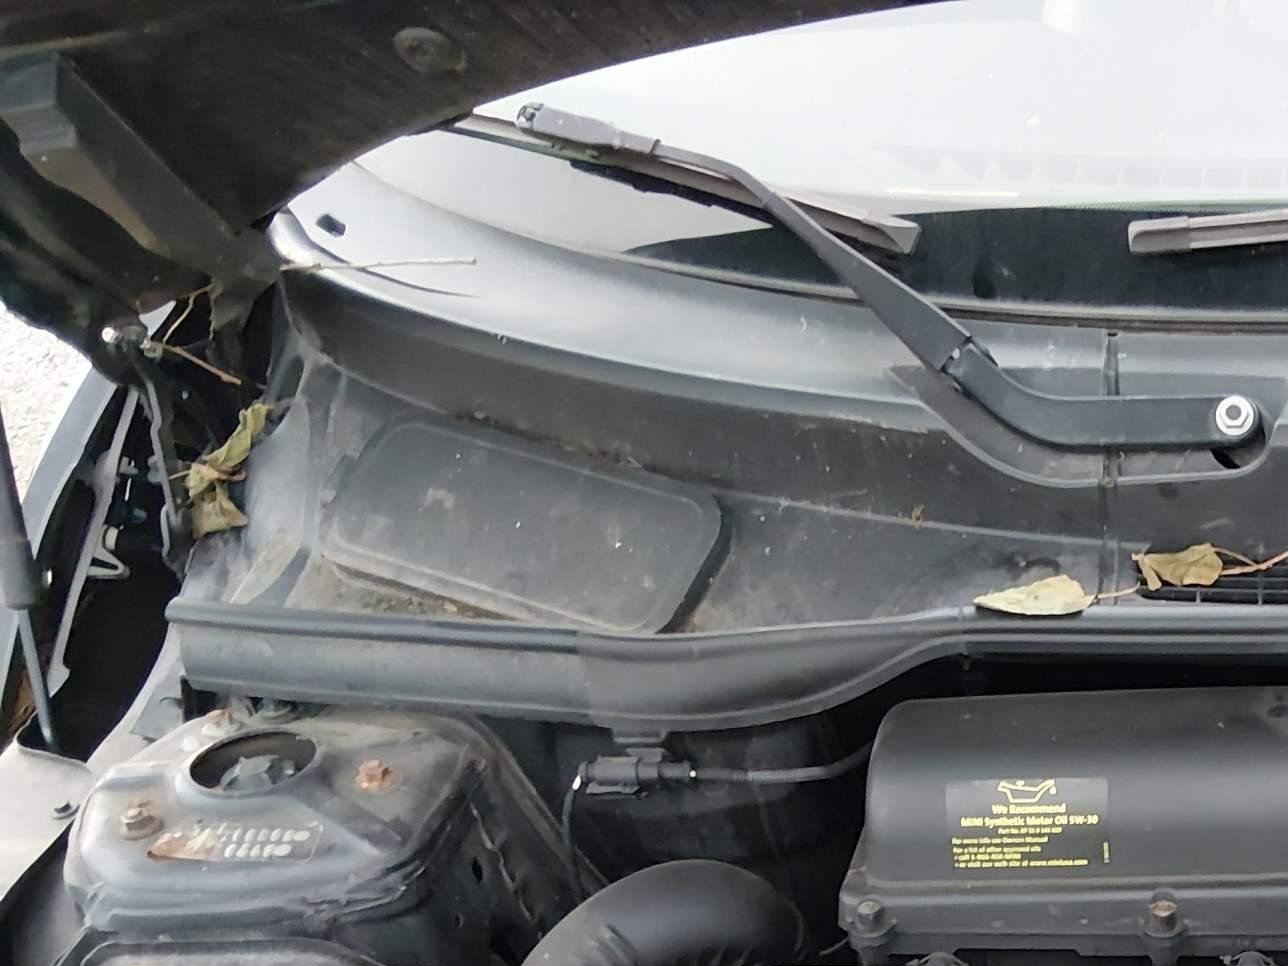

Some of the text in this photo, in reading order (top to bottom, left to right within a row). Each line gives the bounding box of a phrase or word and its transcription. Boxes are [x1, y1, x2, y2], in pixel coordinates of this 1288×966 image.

[1009, 802, 1067, 814] Recommend
[984, 816, 1025, 829] Synthetic
[1026, 815, 1053, 825] Motor
[1054, 814, 1068, 825] Oil
[1069, 814, 1099, 825] 5W-30
